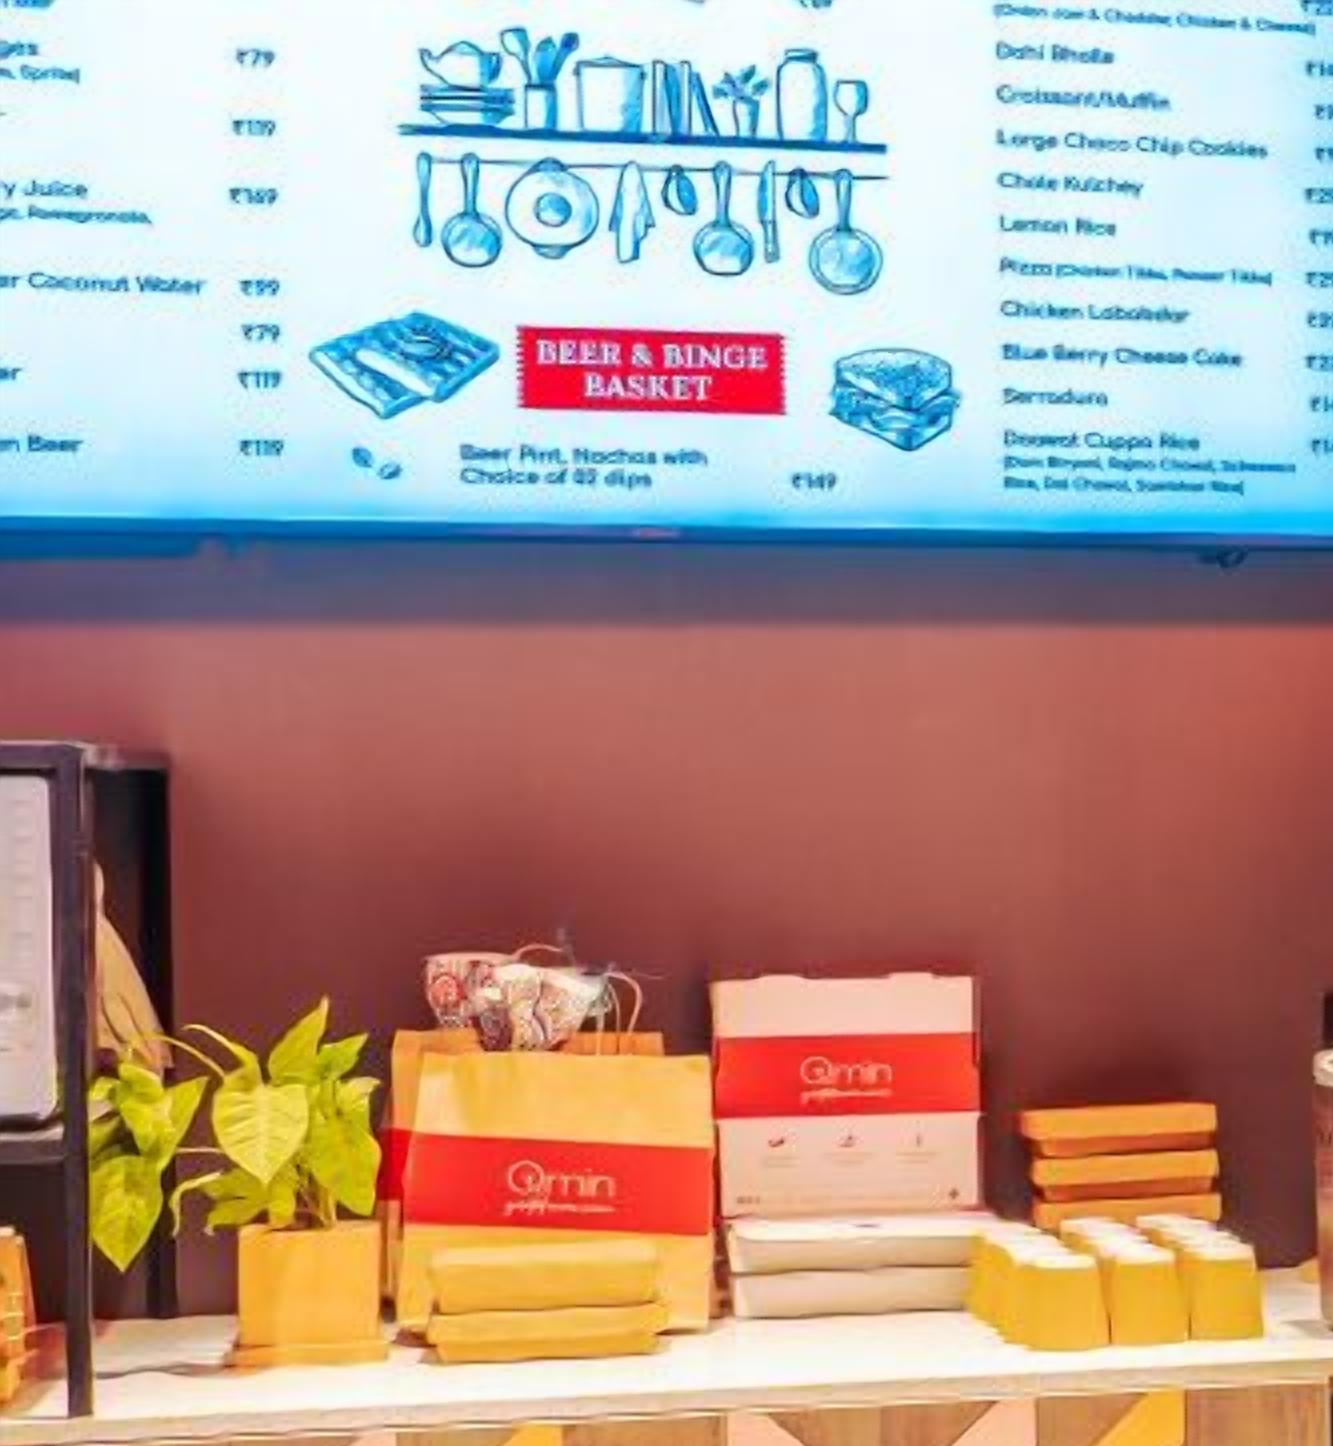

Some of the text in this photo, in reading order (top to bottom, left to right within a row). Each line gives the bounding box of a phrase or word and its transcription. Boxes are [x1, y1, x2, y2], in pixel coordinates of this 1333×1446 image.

[995, 129, 1060, 153] Large
[1134, 136, 1186, 157] Chip
[1187, 138, 1268, 159] Cookies
[998, 214, 1117, 237] Lemon Rice
[26, 271, 131, 293] Coconut
[134, 275, 207, 296] Water
[1000, 300, 1085, 320] Chicken
[536, 339, 768, 371] BEER & BINGE
[584, 373, 713, 402] BASKET
[1158, 432, 1200, 451] Rice
[603, 469, 652, 491] dips
